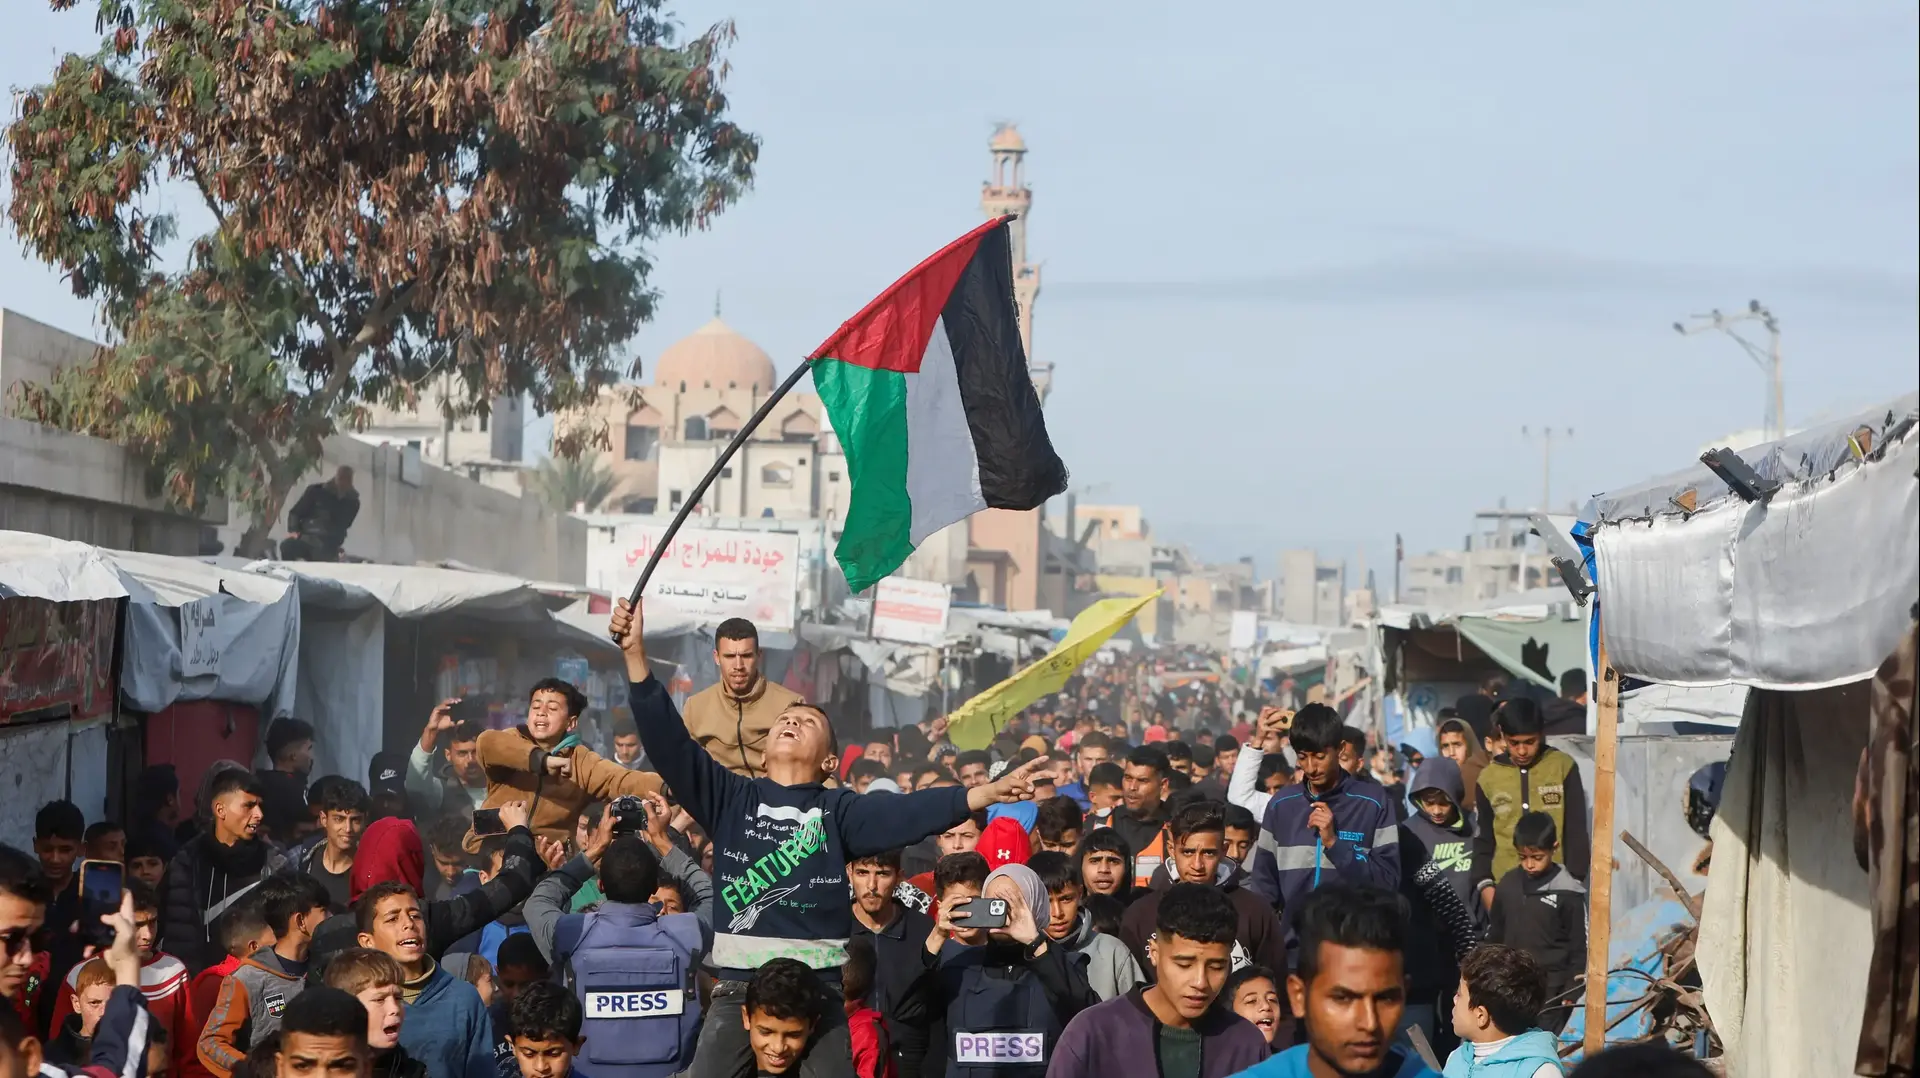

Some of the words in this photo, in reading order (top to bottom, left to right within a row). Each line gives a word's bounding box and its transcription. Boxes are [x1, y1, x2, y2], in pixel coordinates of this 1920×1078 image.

[625, 534, 677, 568] الالي
[681, 536, 738, 568] للمزاج
[743, 540, 784, 574] جودة
[658, 584, 709, 597] السعادة
[711, 588, 748, 603] صانع
[1338, 831, 1364, 842] URRENT
[1433, 842, 1465, 860] NIKE
[1454, 858, 1472, 872] SB
[597, 993, 668, 1012] PRESS
[960, 1036, 1040, 1058] PRESS
